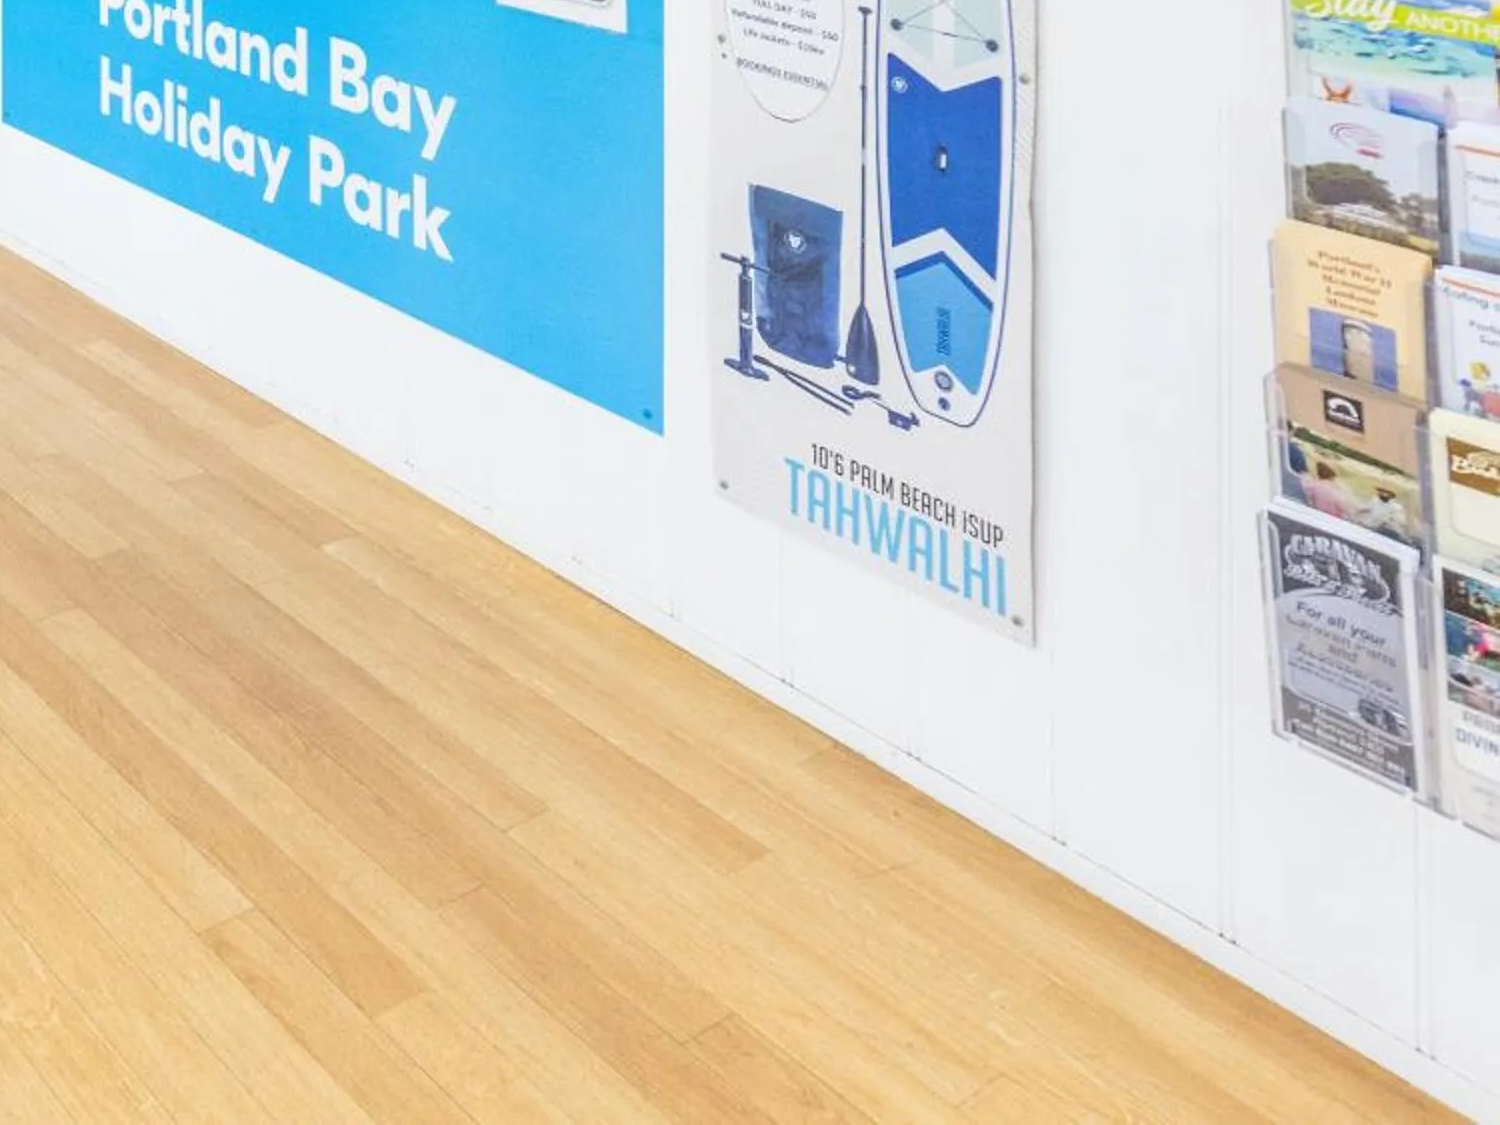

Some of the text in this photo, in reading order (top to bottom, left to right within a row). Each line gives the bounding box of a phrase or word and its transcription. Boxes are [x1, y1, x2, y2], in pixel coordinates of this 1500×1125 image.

[100, 54, 454, 263] Holiday Park
[330, 36, 457, 162] Bay
[783, 456, 1006, 617] TAHWALHI
[850, 459, 895, 500] PALM
[900, 482, 956, 528] BEACH
[1296, 601, 1386, 648] For all your
